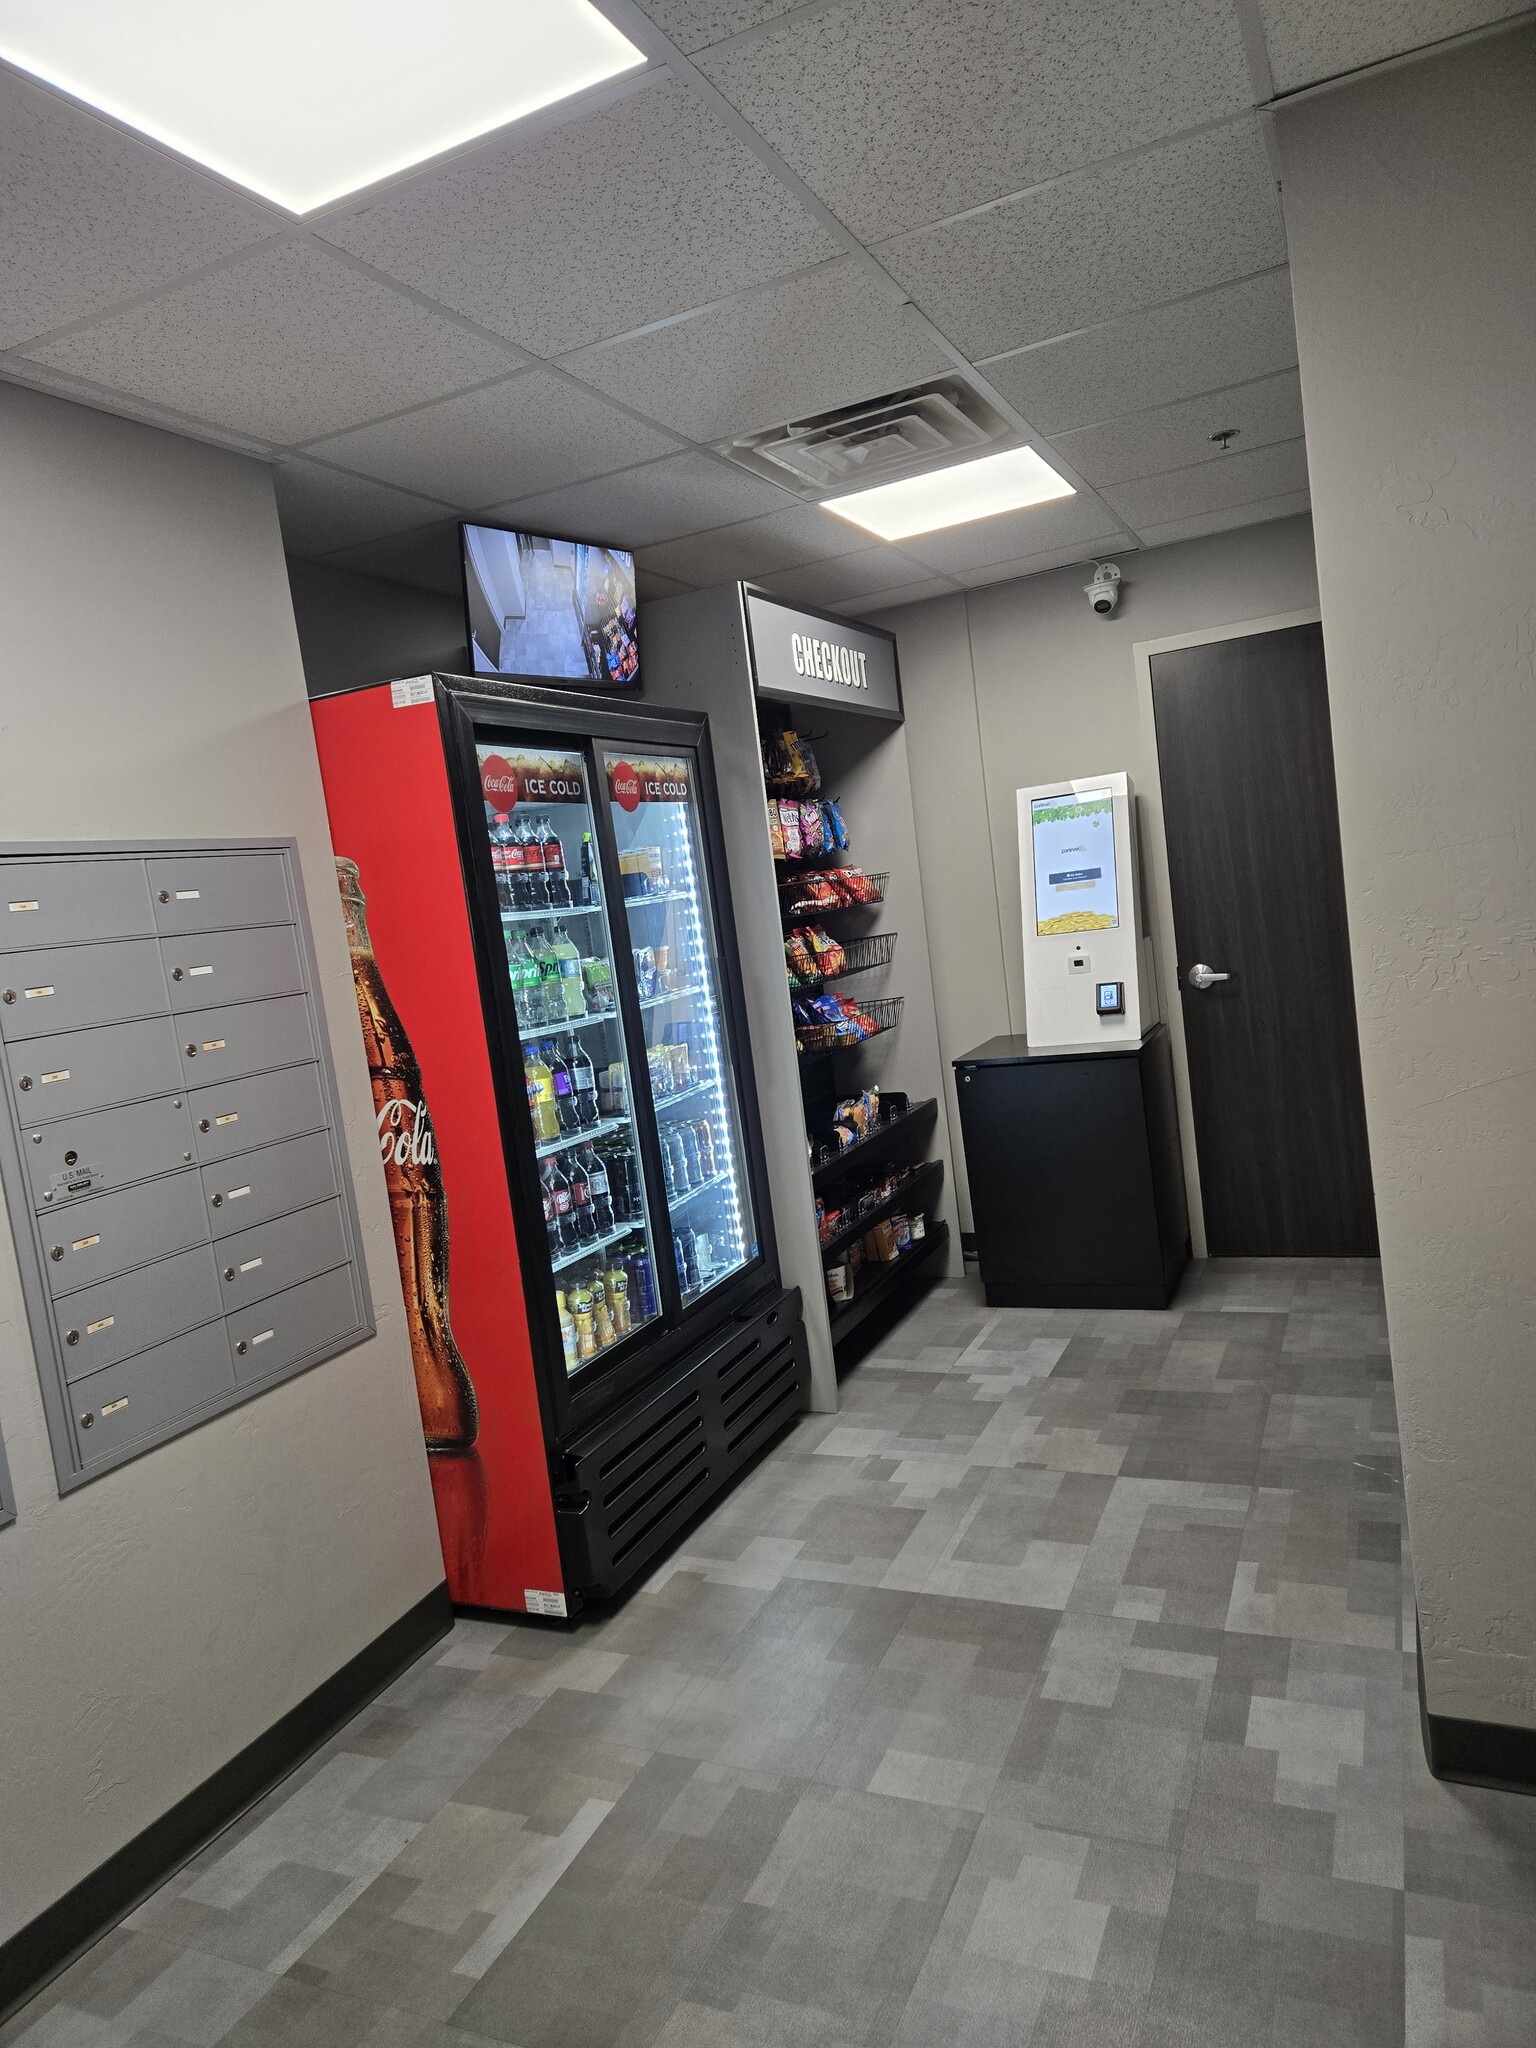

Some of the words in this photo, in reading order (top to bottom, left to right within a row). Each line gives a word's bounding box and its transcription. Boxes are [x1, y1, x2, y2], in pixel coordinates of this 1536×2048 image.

[791, 632, 869, 689] CHECKOUT
[484, 774, 515, 793] Coca-Cola
[524, 778, 547, 795] ICE
[549, 780, 581, 796] COLD
[615, 779, 638, 794] Coca-Cola
[645, 781, 662, 795] ICE
[663, 782, 687, 796] COLD
[76, 1167, 92, 1176] MAIL
